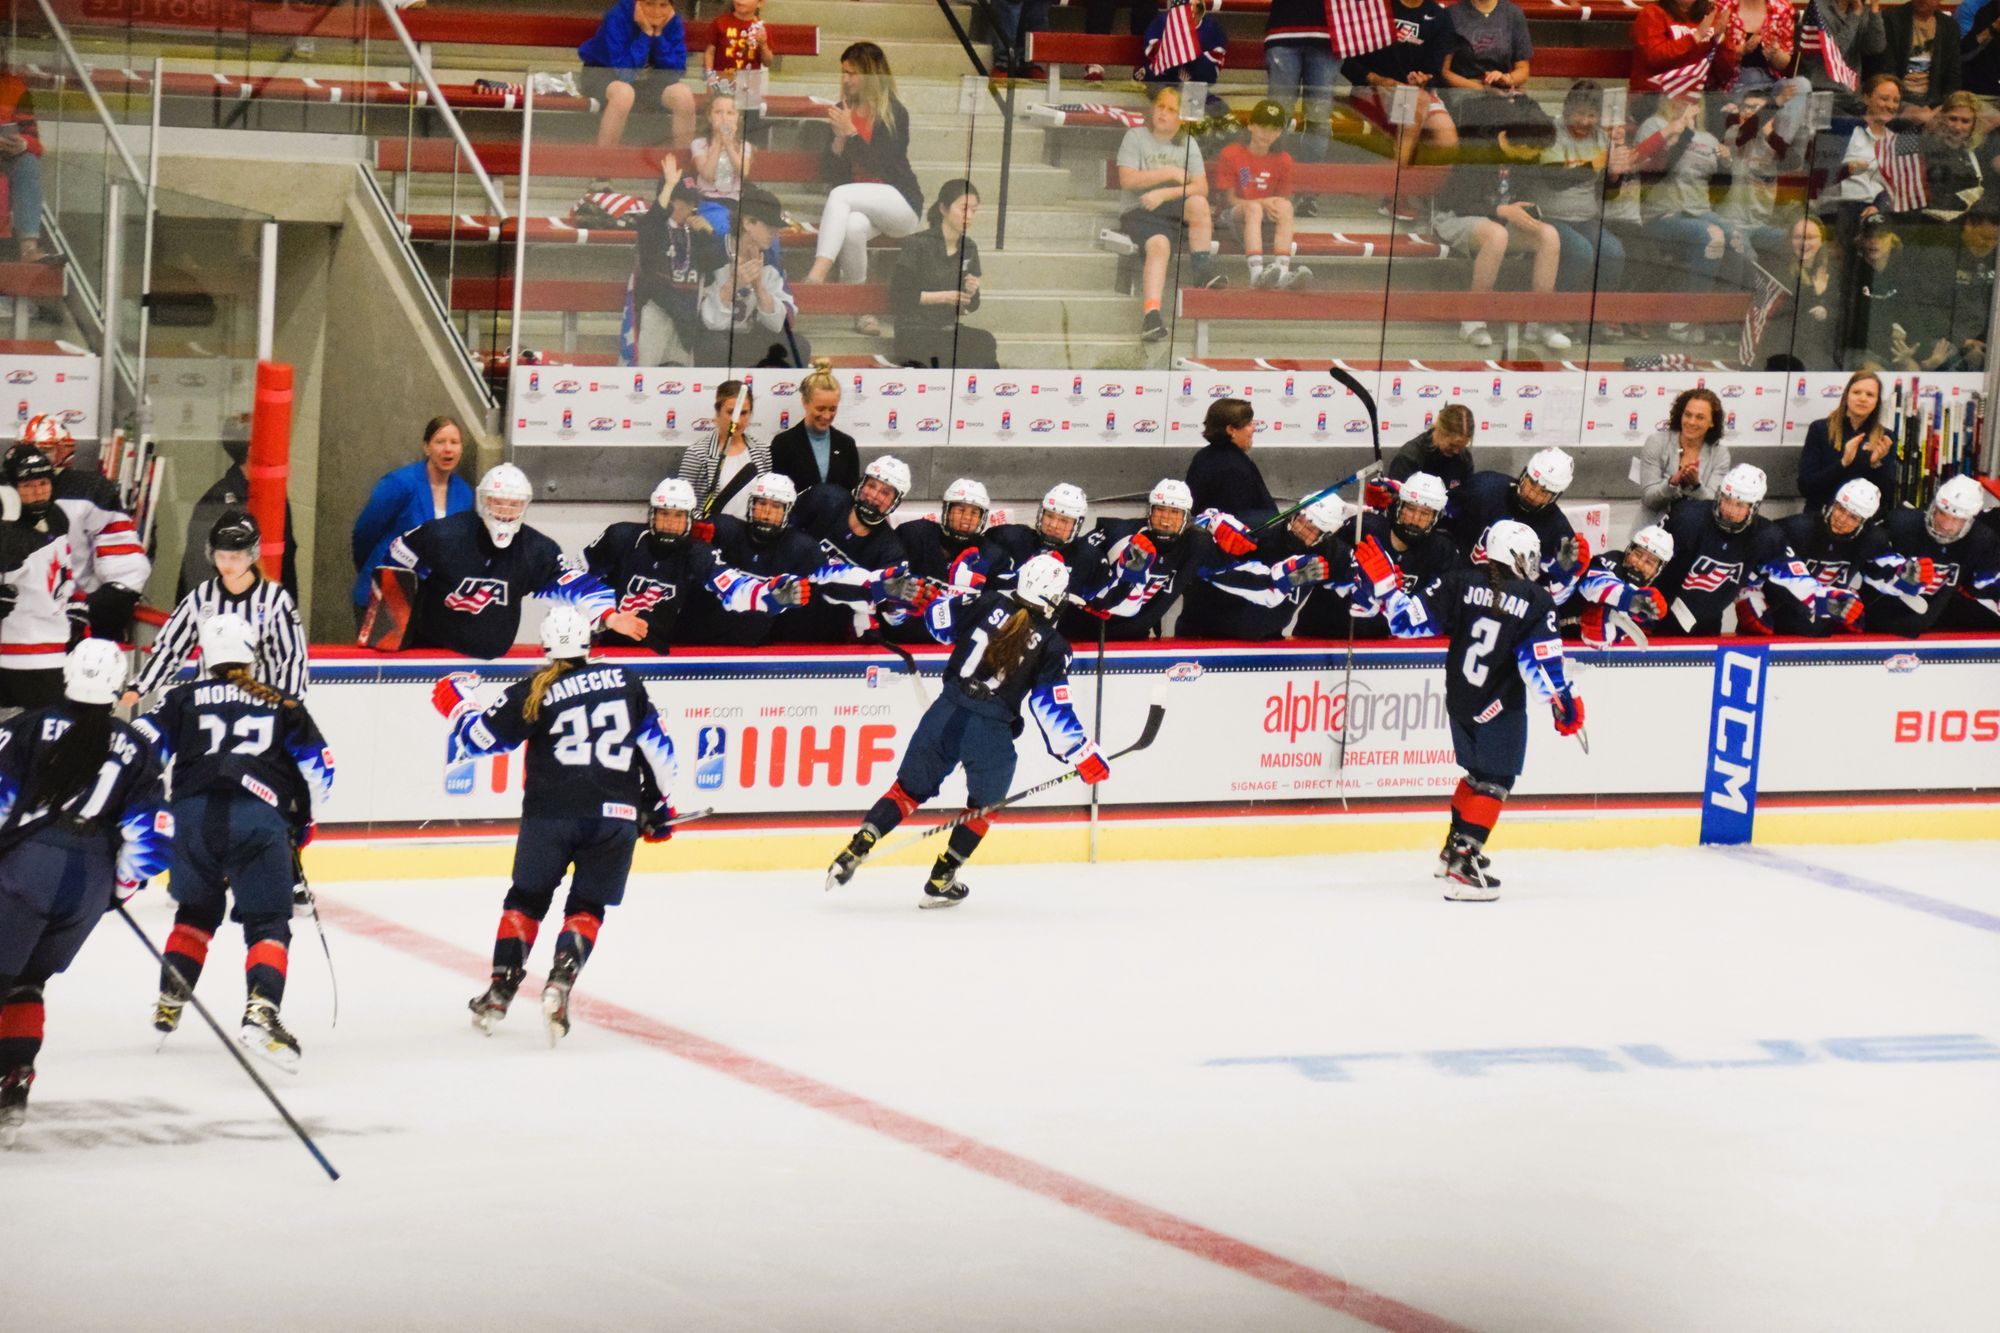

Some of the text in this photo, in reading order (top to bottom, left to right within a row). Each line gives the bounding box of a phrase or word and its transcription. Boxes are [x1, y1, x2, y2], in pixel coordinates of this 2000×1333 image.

[1682, 555, 1743, 592] USA
[1462, 616, 1502, 687] 2
[542, 668, 627, 706] JANECKE
[685, 706, 743, 719] IIHF.com
[760, 705, 818, 717] IIHF.com
[834, 703, 891, 716] IIHF.com
[550, 699, 634, 772] 22
[1710, 651, 1761, 814] CCM
[1895, 709, 2000, 743] BIOS
[739, 724, 896, 788] IIHF
[1260, 752, 1322, 768] MADISON
[1343, 750, 1399, 766] GREATER
[447, 778, 472, 790] IIHF
[698, 774, 720, 785] IIHF
[1231, 781, 1278, 791] SIGNAGE
[1293, 779, 1331, 790] DIRECT
[1336, 779, 1361, 788] MAIL
[1376, 778, 1423, 788] GRAPHIC
